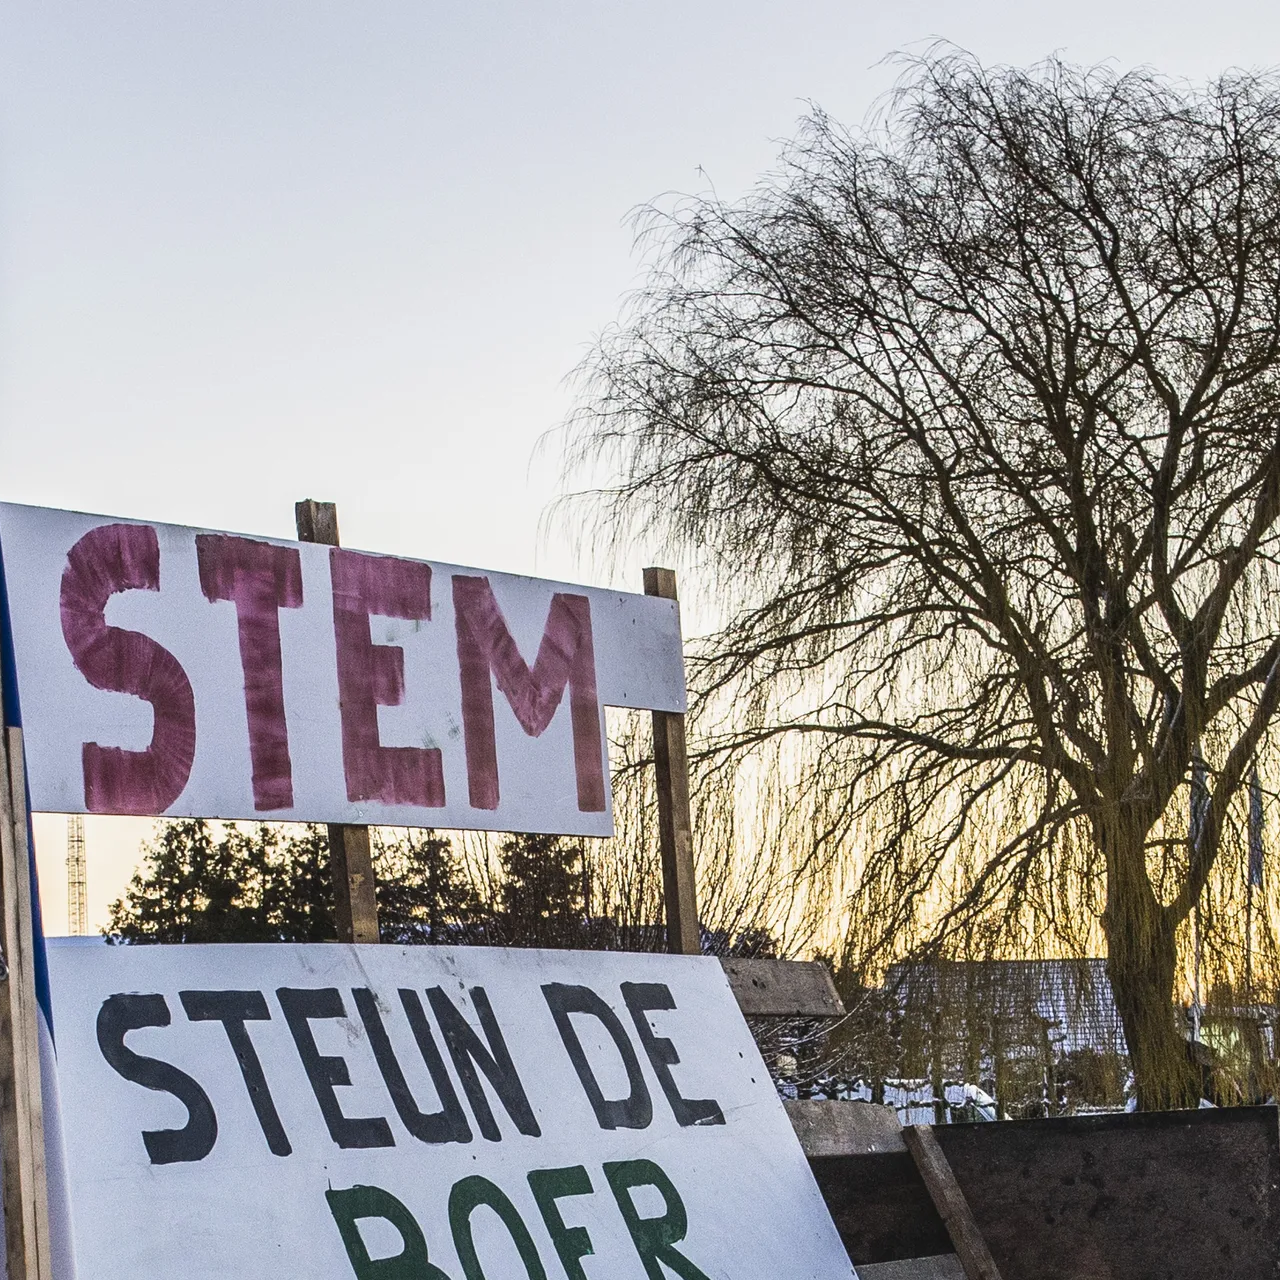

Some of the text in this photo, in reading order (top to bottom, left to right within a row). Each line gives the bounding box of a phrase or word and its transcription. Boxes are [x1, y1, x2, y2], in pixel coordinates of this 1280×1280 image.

[60, 523, 606, 814] STEM
[96, 981, 726, 1165] STEUN DE
